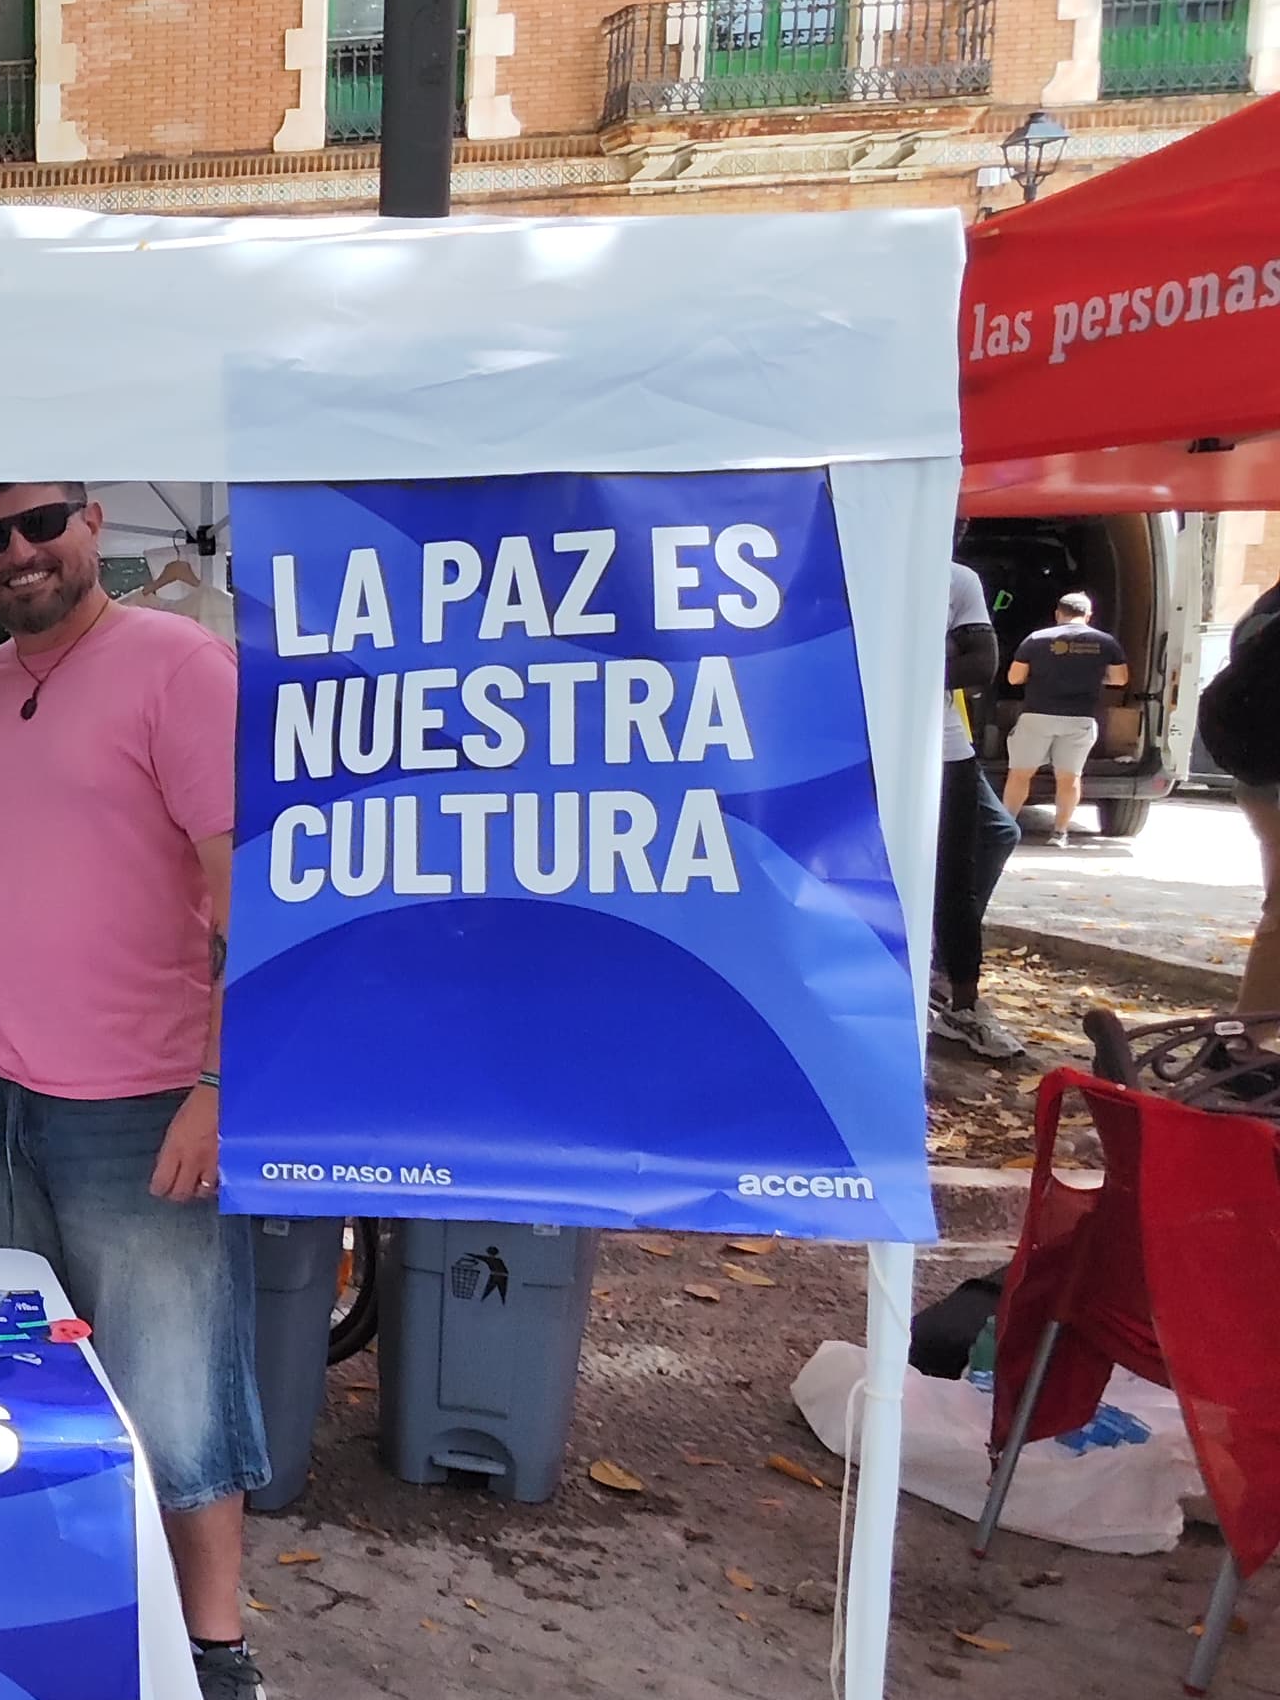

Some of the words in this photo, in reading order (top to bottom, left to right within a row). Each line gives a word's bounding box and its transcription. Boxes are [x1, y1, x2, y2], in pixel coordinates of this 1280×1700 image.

[969, 304, 1032, 363] las
[1049, 257, 1280, 365] personas
[272, 548, 394, 658] LA
[421, 528, 616, 644] PAZ
[652, 523, 781, 632] ES
[274, 655, 753, 781] NUESTRA
[269, 788, 739, 903] CULTURA
[261, 1163, 324, 1182] OTRO
[332, 1163, 392, 1184] PASO
[400, 1164, 451, 1186] MÁS
[738, 1172, 872, 1200] accem
